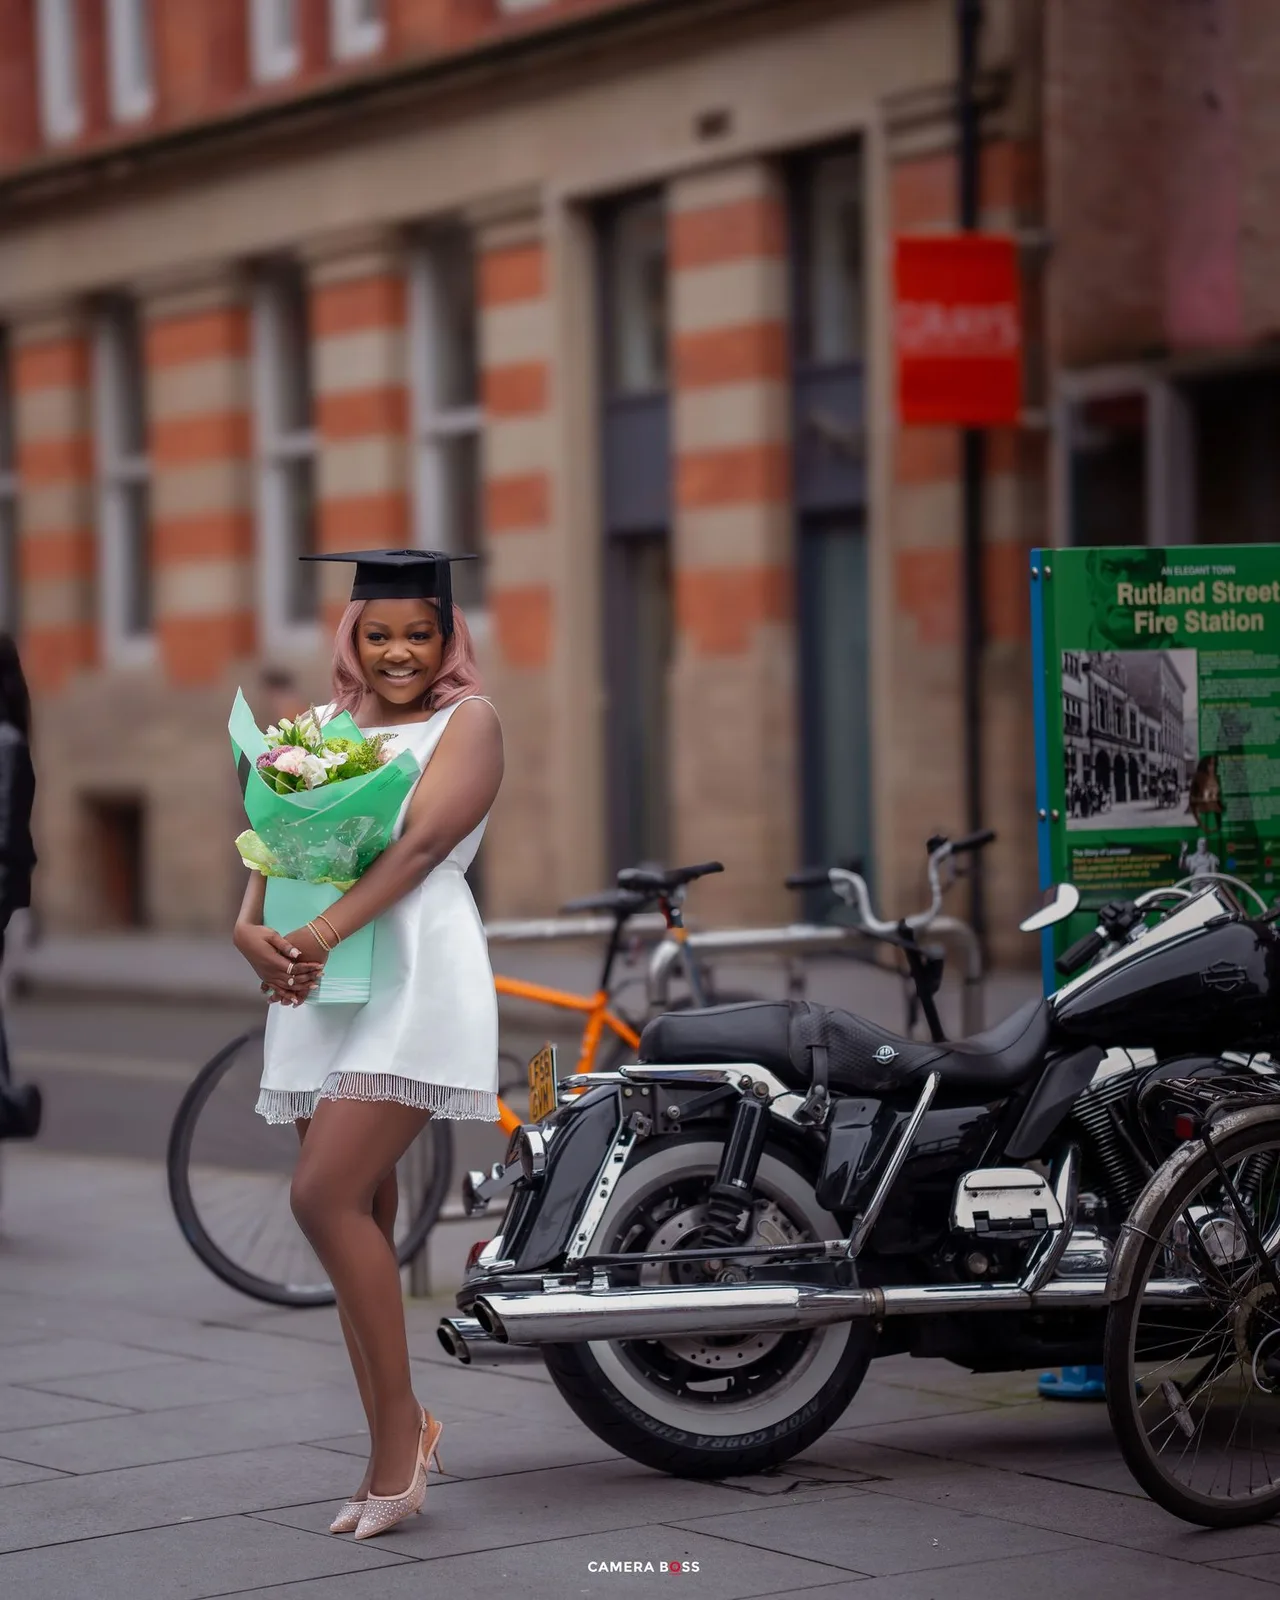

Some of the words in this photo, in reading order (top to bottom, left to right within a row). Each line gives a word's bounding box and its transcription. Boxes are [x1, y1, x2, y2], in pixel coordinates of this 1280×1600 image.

[1161, 566, 1174, 576] AN
[1174, 566, 1210, 576] ELEGANT
[1211, 565, 1236, 575] TOWN
[1117, 581, 1205, 606] Rutland
[1212, 580, 1280, 604] Street
[1134, 610, 1178, 634] Fire
[1185, 609, 1264, 633] Station
[774, 1396, 820, 1437] AVON
[695, 1430, 768, 1448] COBRA
